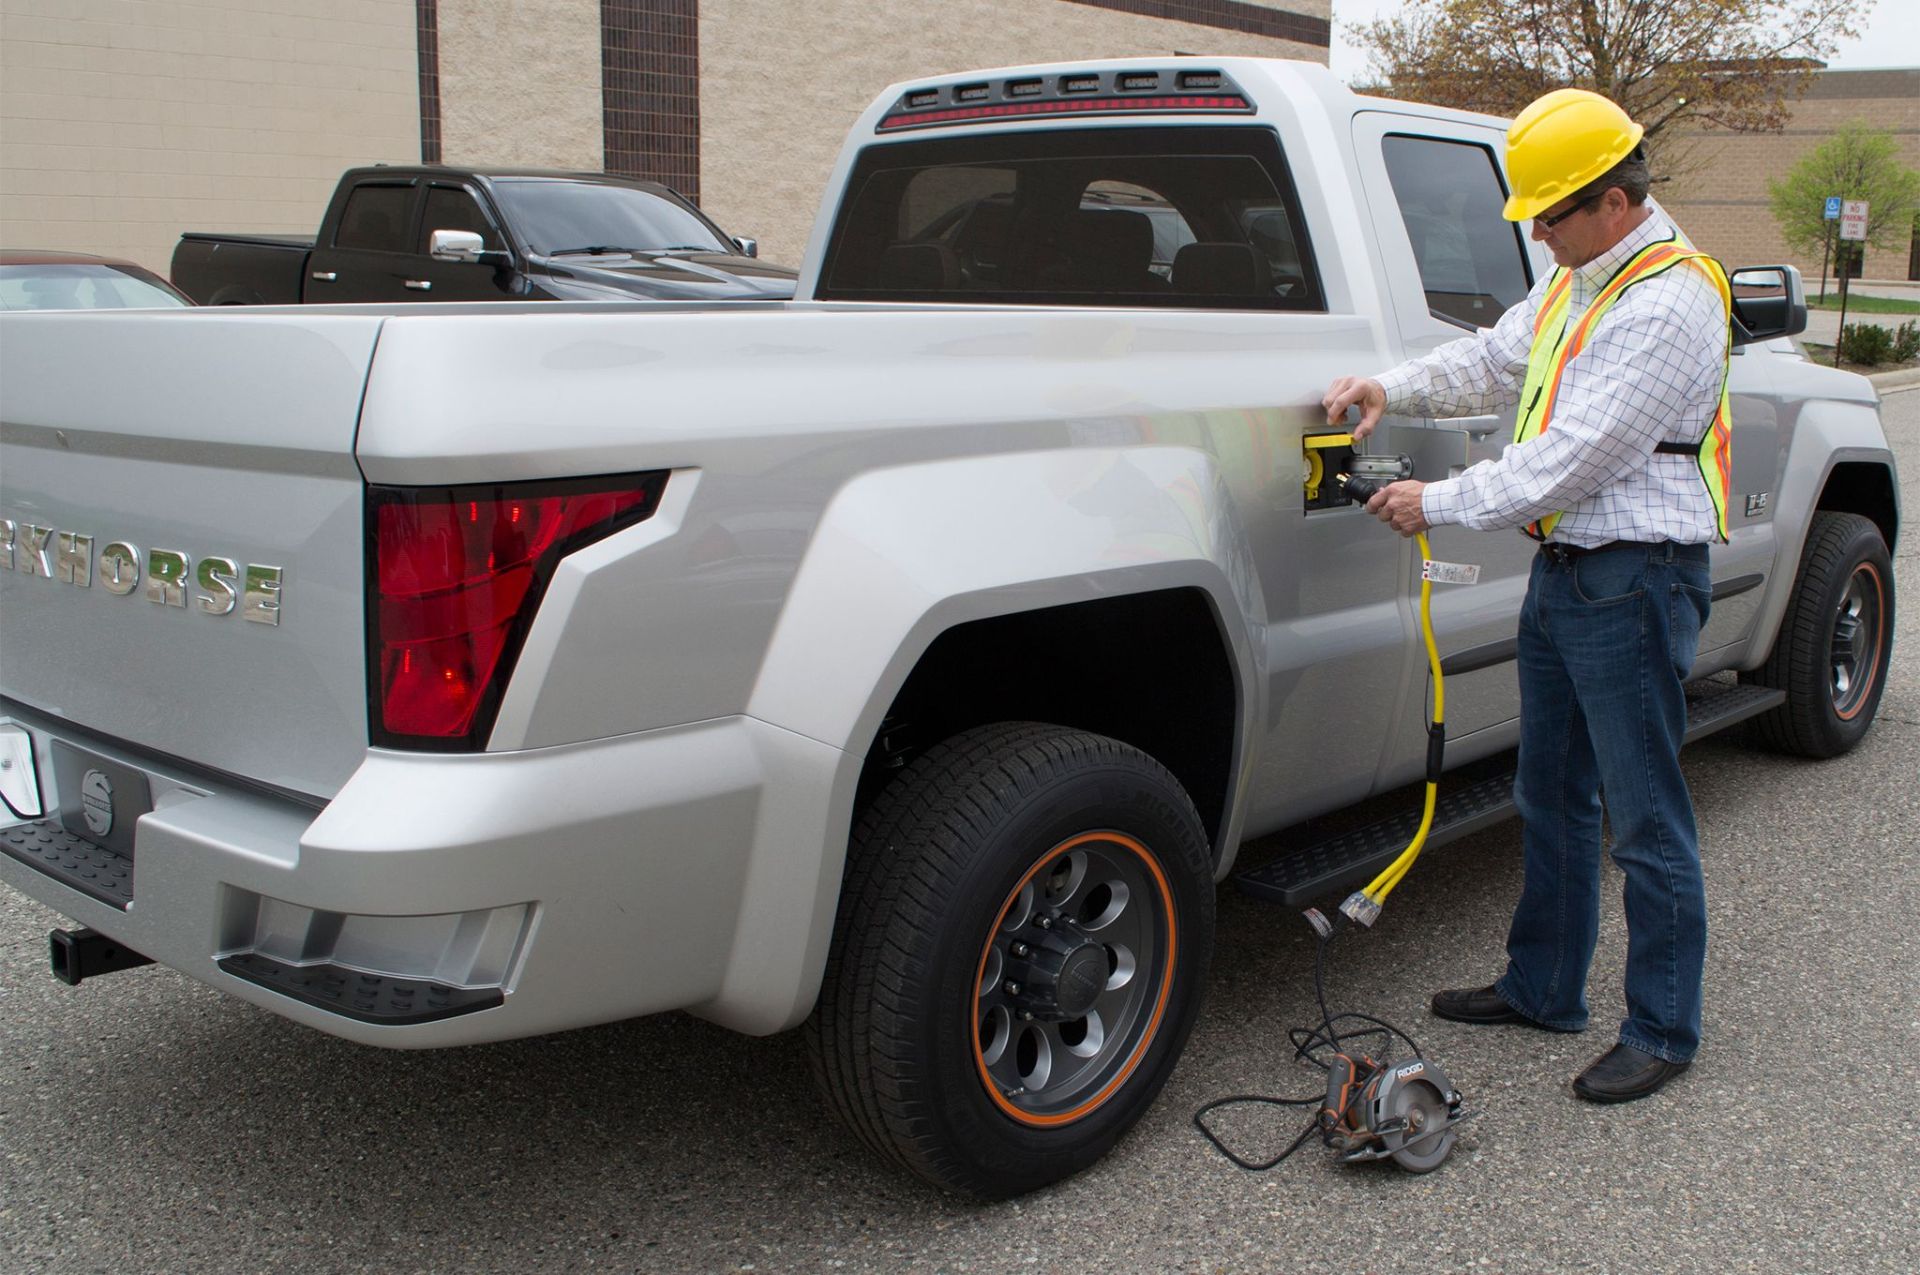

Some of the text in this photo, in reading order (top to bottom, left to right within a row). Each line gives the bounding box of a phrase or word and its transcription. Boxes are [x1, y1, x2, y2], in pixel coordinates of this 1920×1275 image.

[1842, 214, 1867, 222] PARKING
[1134, 789, 1204, 875] MICHELIN
[1397, 1062, 1424, 1078] RIDGID
